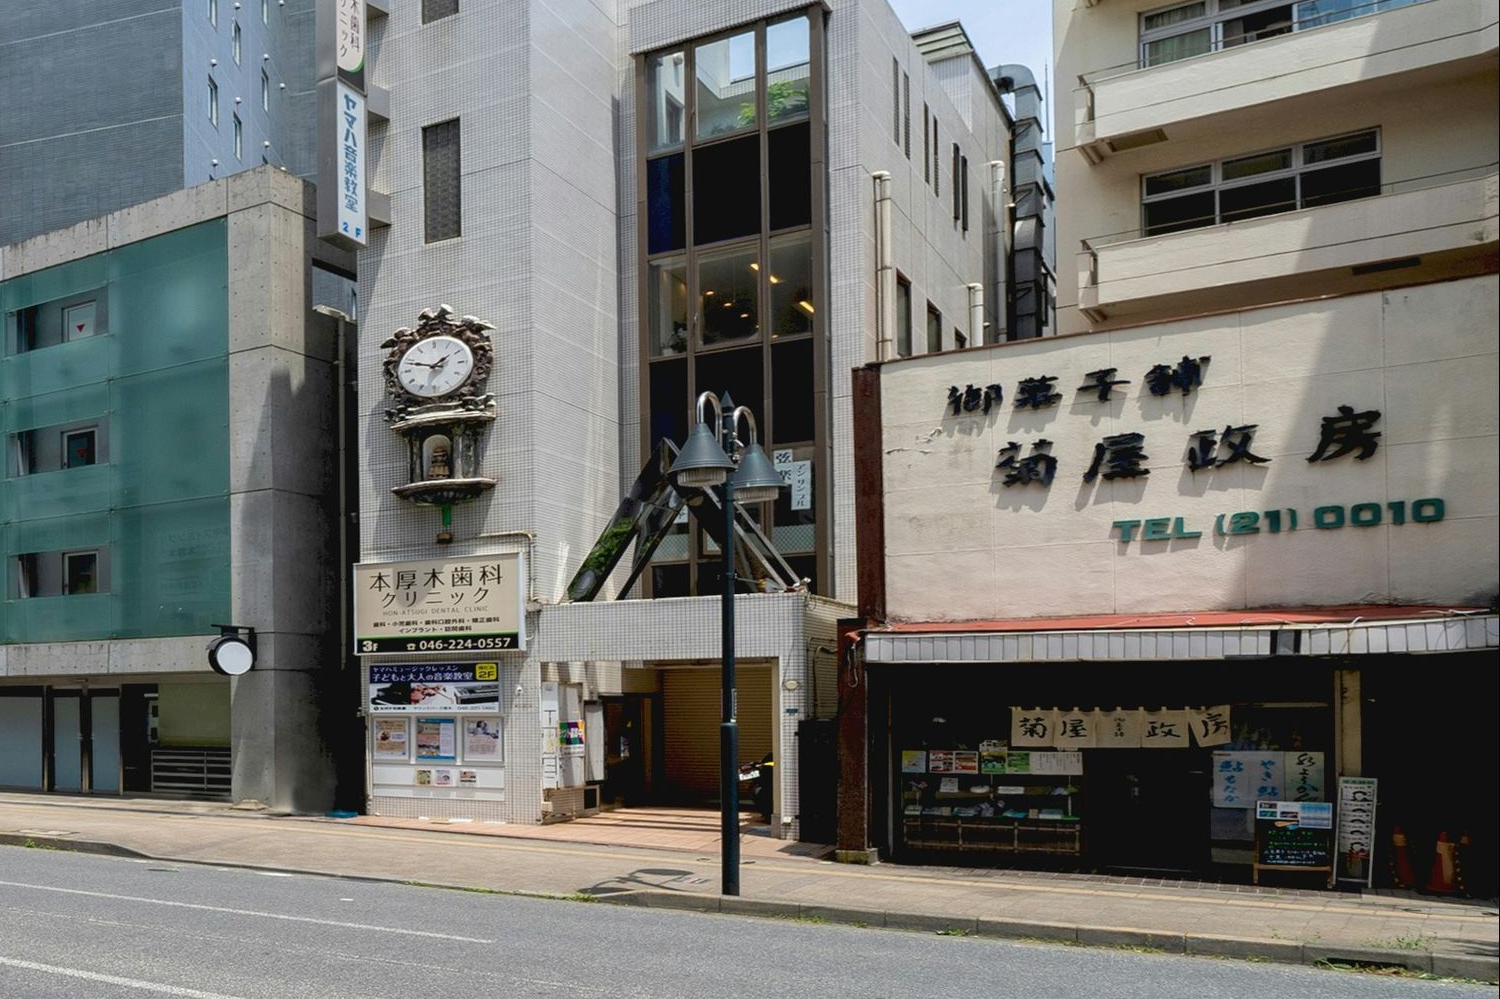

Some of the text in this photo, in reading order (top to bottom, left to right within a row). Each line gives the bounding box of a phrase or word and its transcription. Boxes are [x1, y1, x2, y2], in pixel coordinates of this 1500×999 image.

[344, 93, 358, 213] ヤマハ音楽教室
[996, 404, 1382, 488] 菊屋政房
[1112, 516, 1202, 543] TEL
[1314, 497, 1445, 529] 0010
[369, 564, 503, 592] 本厚木歯科
[381, 587, 489, 608] クリニック
[431, 607, 460, 615] DENTAL
[464, 605, 489, 613] CLINIC
[362, 637, 511, 651] 3F 046-224-0557
[372, 671, 474, 682] 子どもと大人の音楽教室
[478, 671, 495, 679] 2F
